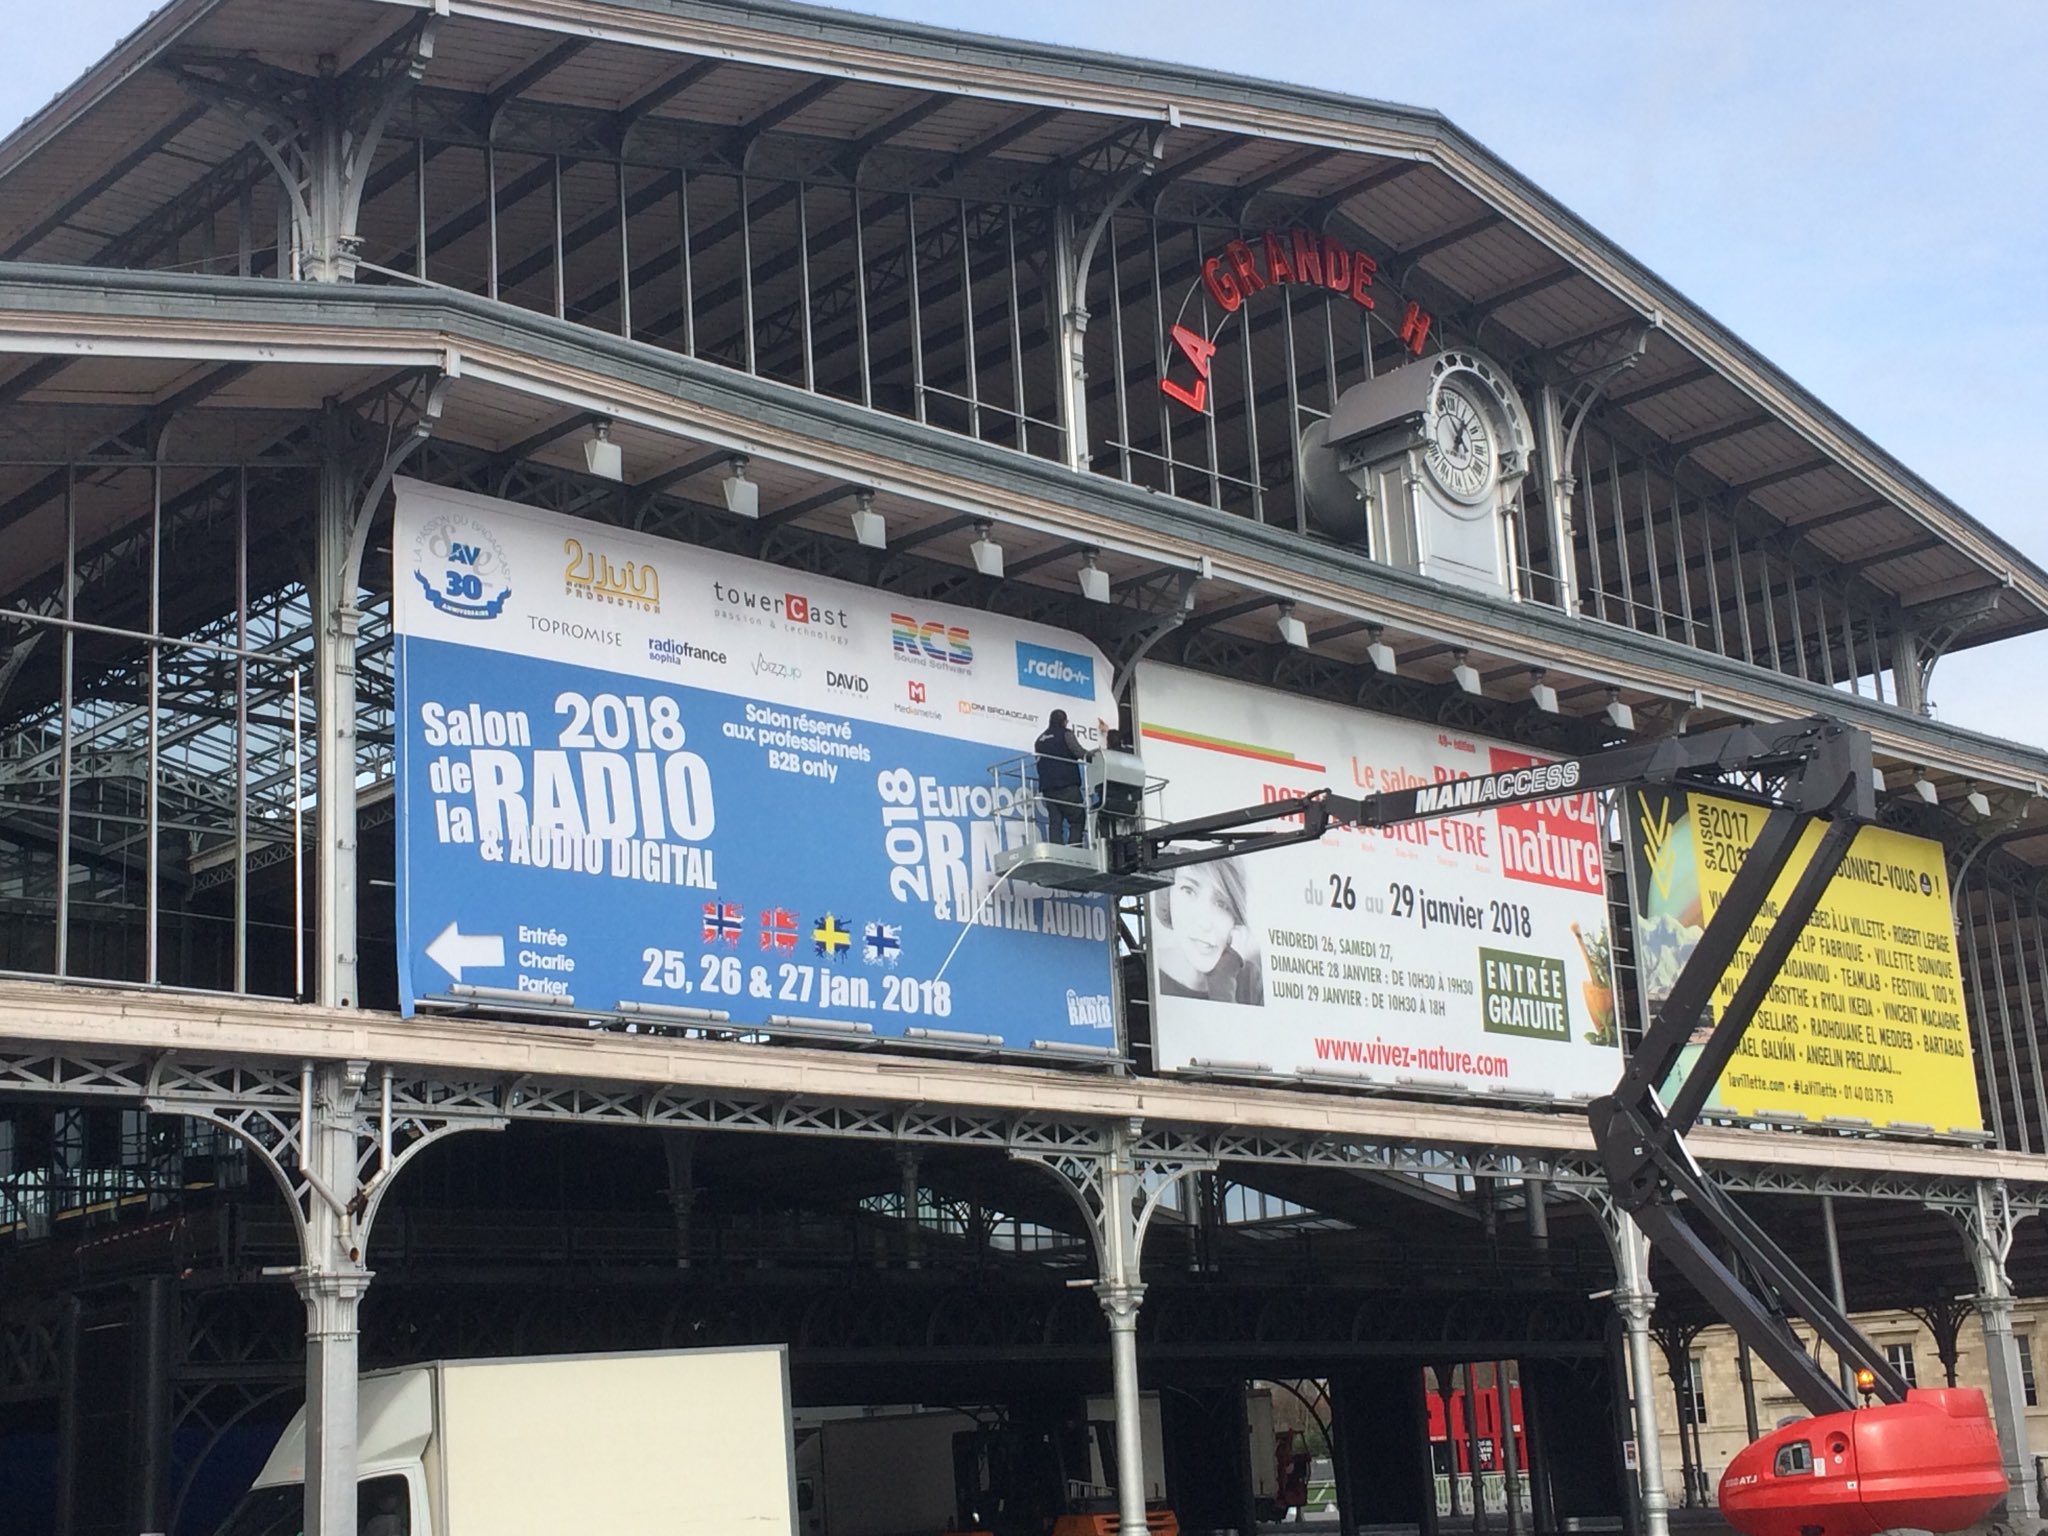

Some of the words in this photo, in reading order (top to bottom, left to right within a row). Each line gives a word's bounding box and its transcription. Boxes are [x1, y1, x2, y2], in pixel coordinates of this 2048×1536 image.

[1162, 324, 1217, 413] LA
[1202, 229, 1377, 311] GRANDE
[445, 570, 482, 600] 30
[566, 588, 661, 614] PRODUCTION
[527, 615, 622, 647] TOPROMISE
[891, 612, 973, 665] RCS
[893, 653, 927, 669] Sound
[928, 659, 973, 677] Software
[421, 702, 531, 747] Salon
[554, 691, 685, 751] 2018
[745, 703, 792, 730] Salon
[793, 713, 852, 740] réservé
[722, 722, 756, 741] aux
[758, 728, 871, 762] professionnels
[430, 756, 472, 793] de
[769, 749, 800, 773] B2B
[802, 759, 838, 784] only
[1352, 756, 1374, 789] Le
[470, 749, 715, 841] RADIO
[1415, 761, 1580, 814] MANIACCESS
[435, 800, 475, 843] la
[877, 767, 929, 902] 2018
[1697, 803, 1717, 871] SAISON
[1710, 806, 1749, 843] 2017
[480, 823, 503, 861] &
[510, 824, 603, 875] AUDIO
[610, 837, 718, 890] DIGITAL
[1500, 820, 1601, 886] nature
[934, 890, 951, 921] &
[956, 888, 1038, 932] DIGITAL
[1042, 898, 1106, 942] AUDIO
[1305, 879, 1323, 907] du
[1330, 874, 1356, 911] 26
[1365, 895, 1384, 914] au
[1390, 883, 1414, 918] 29
[1419, 889, 1484, 930] janvier
[1490, 900, 1532, 938] 2018
[519, 925, 568, 947] Entrée
[1268, 929, 1318, 950] VENDREDI
[1321, 936, 1337, 955] 26,
[1339, 938, 1377, 958] SAMEDI
[1379, 944, 1394, 962] 27,
[1850, 917, 1887, 941] VILLETTE
[1893, 925, 1922, 947] ROBERT
[1923, 931, 1950, 953] LEPAGE
[519, 950, 575, 972] Charlie
[1270, 955, 1324, 977] DIMANCHE
[1327, 962, 1340, 979] 28
[1343, 964, 1382, 984] JANVIER
[1391, 970, 1404, 987] DE
[1408, 972, 1436, 990] 10H30
[1447, 977, 1474, 996] 19H30
[1820, 938, 1864, 962] FABRIQUE
[1874, 947, 1915, 972] VILLETTE
[1917, 955, 1954, 979] SONIQUE
[519, 974, 568, 995] Parker
[642, 947, 693, 994] 25,
[700, 954, 741, 995] 26
[749, 966, 772, 999] &
[779, 963, 814, 1002] 27
[819, 968, 876, 1009] jan.
[882, 975, 952, 1017] 2018
[1272, 981, 1304, 1000] LUNDI
[1307, 985, 1319, 1002] 29
[1322, 986, 1362, 1007] JANVIER
[1371, 992, 1384, 1010] DE
[1388, 994, 1417, 1013] 10H30
[1429, 999, 1446, 1016] 18H
[1486, 960, 1562, 999] ENTRÉE
[1840, 967, 1881, 991] TEAMLAB
[1891, 976, 1930, 1000] FESTIVAL
[1488, 994, 1565, 1032] GRATUITE
[1820, 992, 1846, 1013] RYOJI
[1849, 997, 1874, 1017] IKEDA
[1882, 1002, 1918, 1025] VINCENT
[1920, 1008, 1962, 1031] MACAIGNE
[1757, 1012, 1799, 1034] SELLARS
[1810, 1017, 1864, 1043] RADHOUANE
[1866, 1028, 1877, 1044] EL
[1923, 1035, 1965, 1058] BARTABAS
[1761, 1036, 1796, 1062] GALVÁN
[1806, 1045, 1844, 1068] ANGELIN
[1314, 1036, 1508, 1078] www.vivez-nature.com
[1727, 1071, 1785, 1093] lavillette.com
